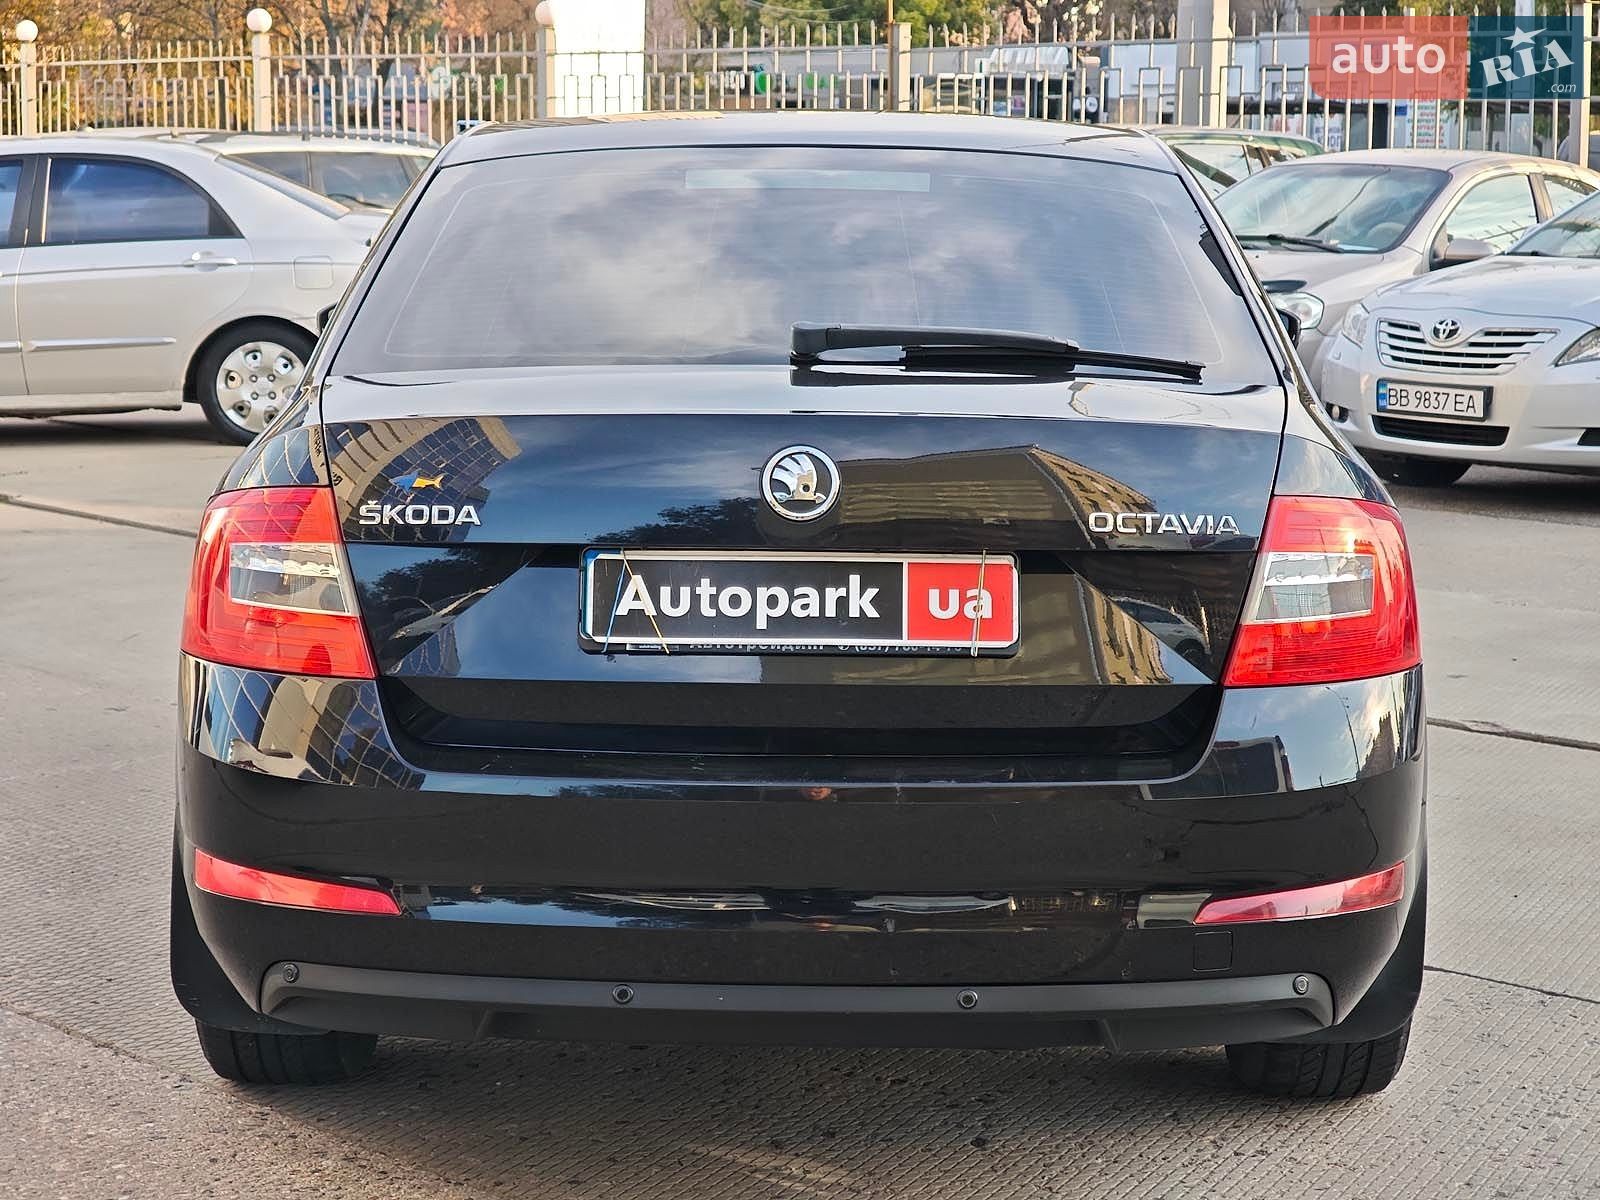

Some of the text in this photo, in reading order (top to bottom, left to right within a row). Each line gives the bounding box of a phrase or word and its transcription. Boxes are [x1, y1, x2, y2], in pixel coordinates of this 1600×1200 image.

[1388, 388, 1477, 413] BB 9837 EA
[359, 500, 481, 525] ŠKODA
[1088, 512, 1241, 535] OCTAVIA
[615, 574, 993, 630] Autopark ua
